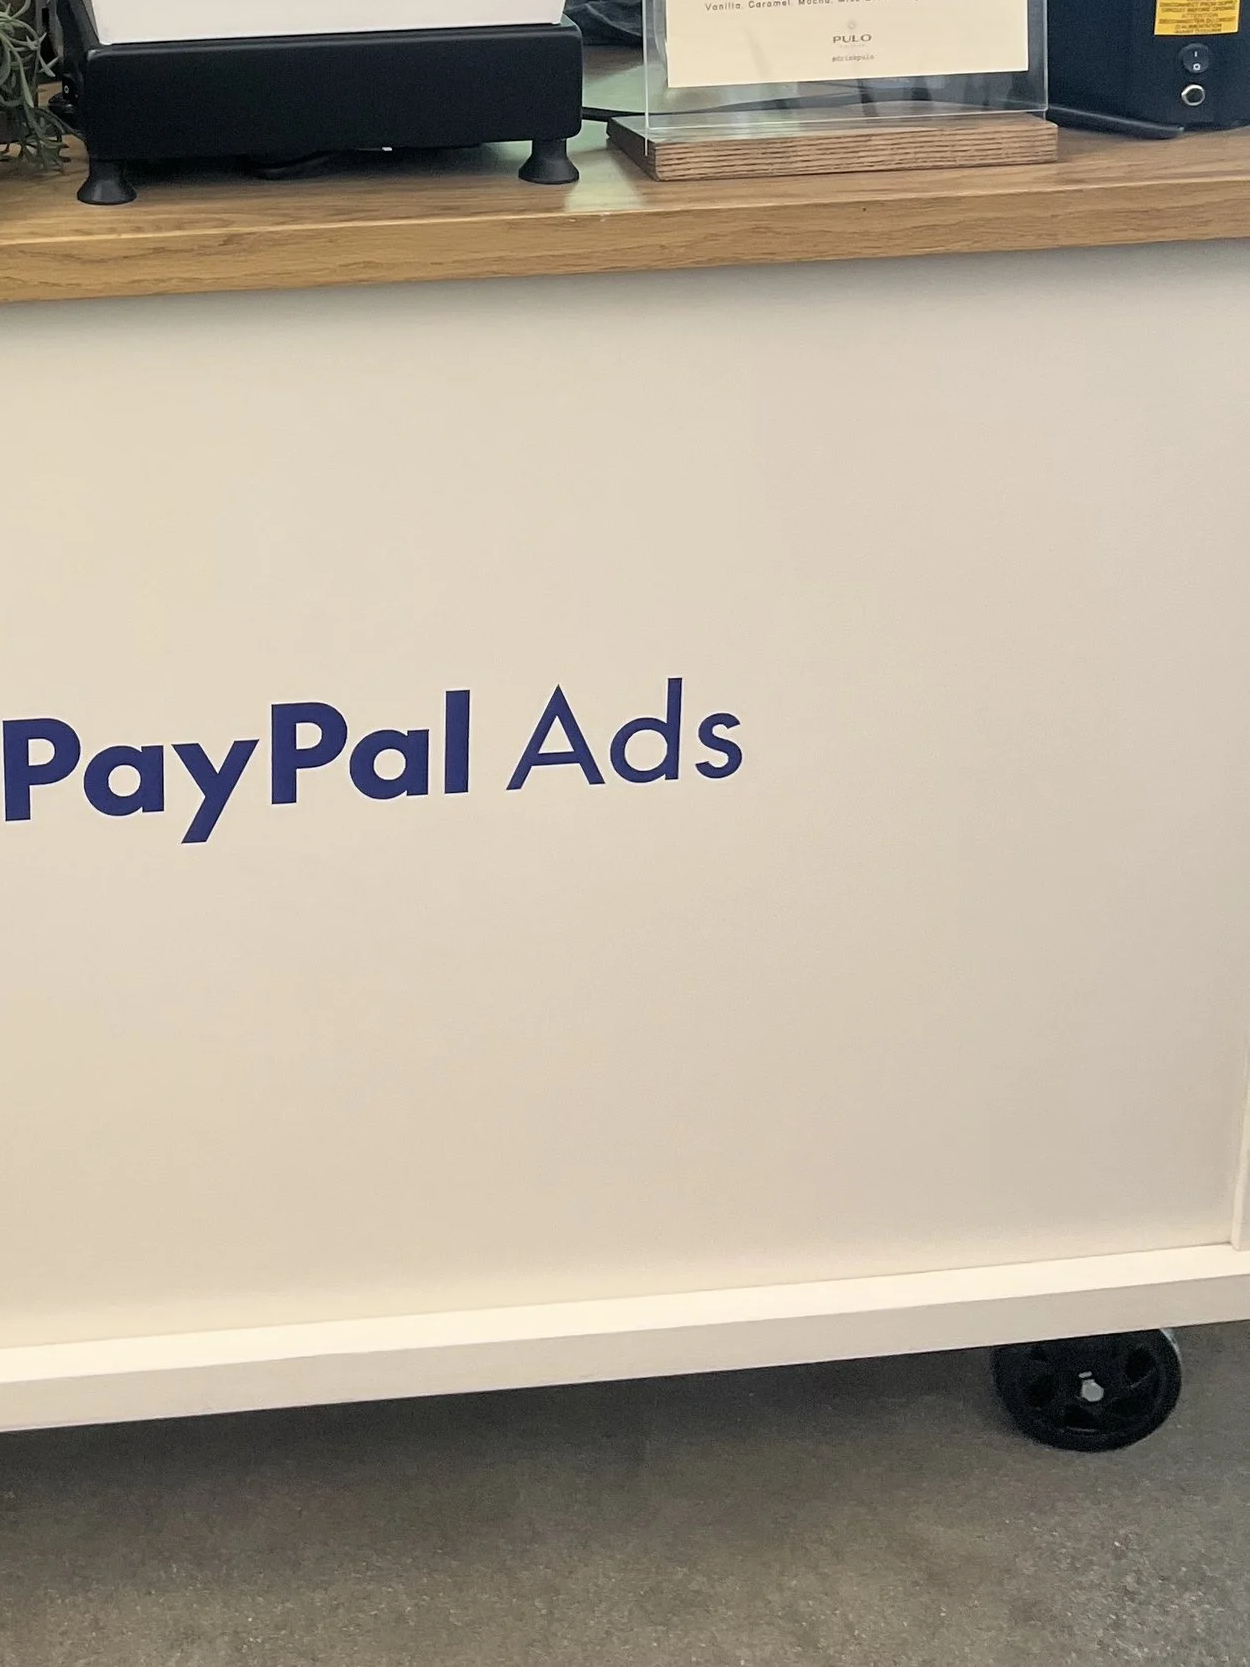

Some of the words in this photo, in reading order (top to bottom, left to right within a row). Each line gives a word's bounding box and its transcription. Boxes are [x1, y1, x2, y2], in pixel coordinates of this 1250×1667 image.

[833, 34, 872, 44] PULO
[1, 689, 471, 844] PayPal
[505, 677, 743, 791] Ads
